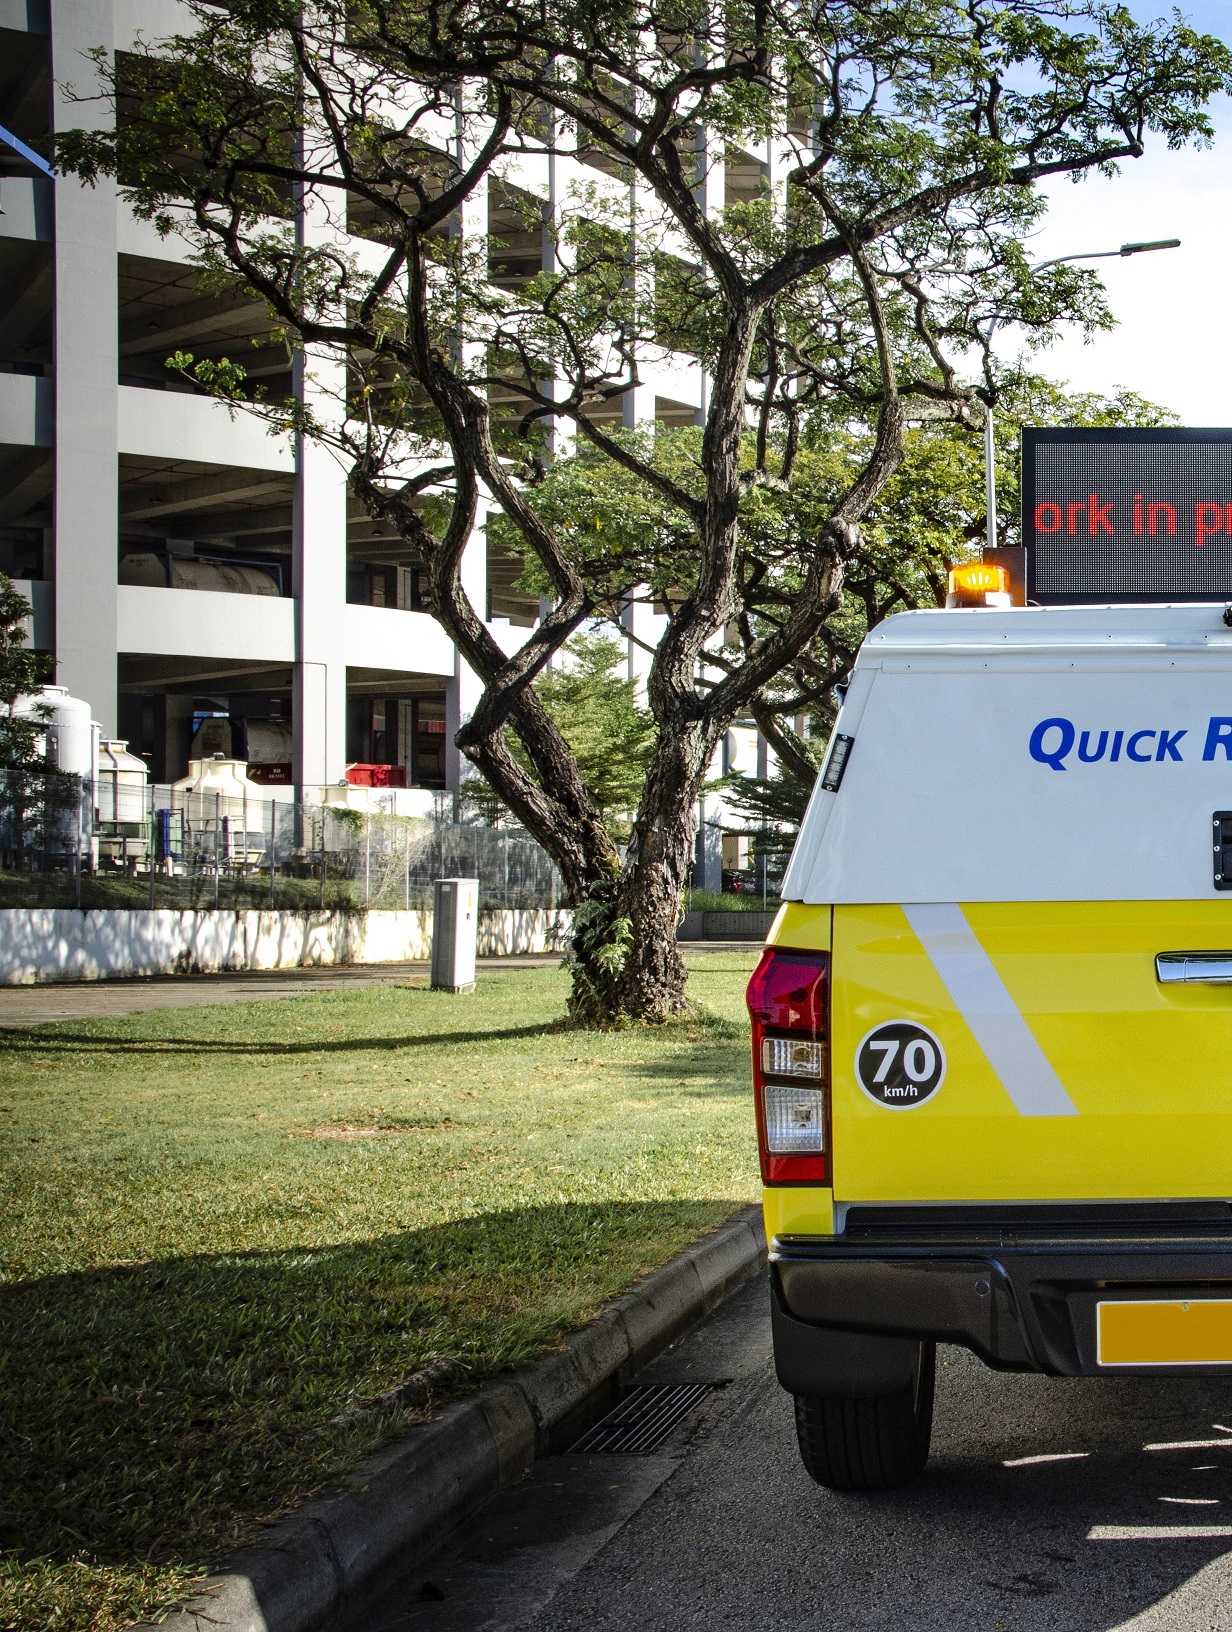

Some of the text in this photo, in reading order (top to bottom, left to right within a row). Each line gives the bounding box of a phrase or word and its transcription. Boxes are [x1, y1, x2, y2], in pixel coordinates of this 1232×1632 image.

[1034, 494, 1115, 535] ork
[1133, 494, 1176, 535] in
[1028, 717, 1188, 771] QUICK
[869, 1038, 936, 1083] 70
[884, 1084, 918, 1097] km/h
